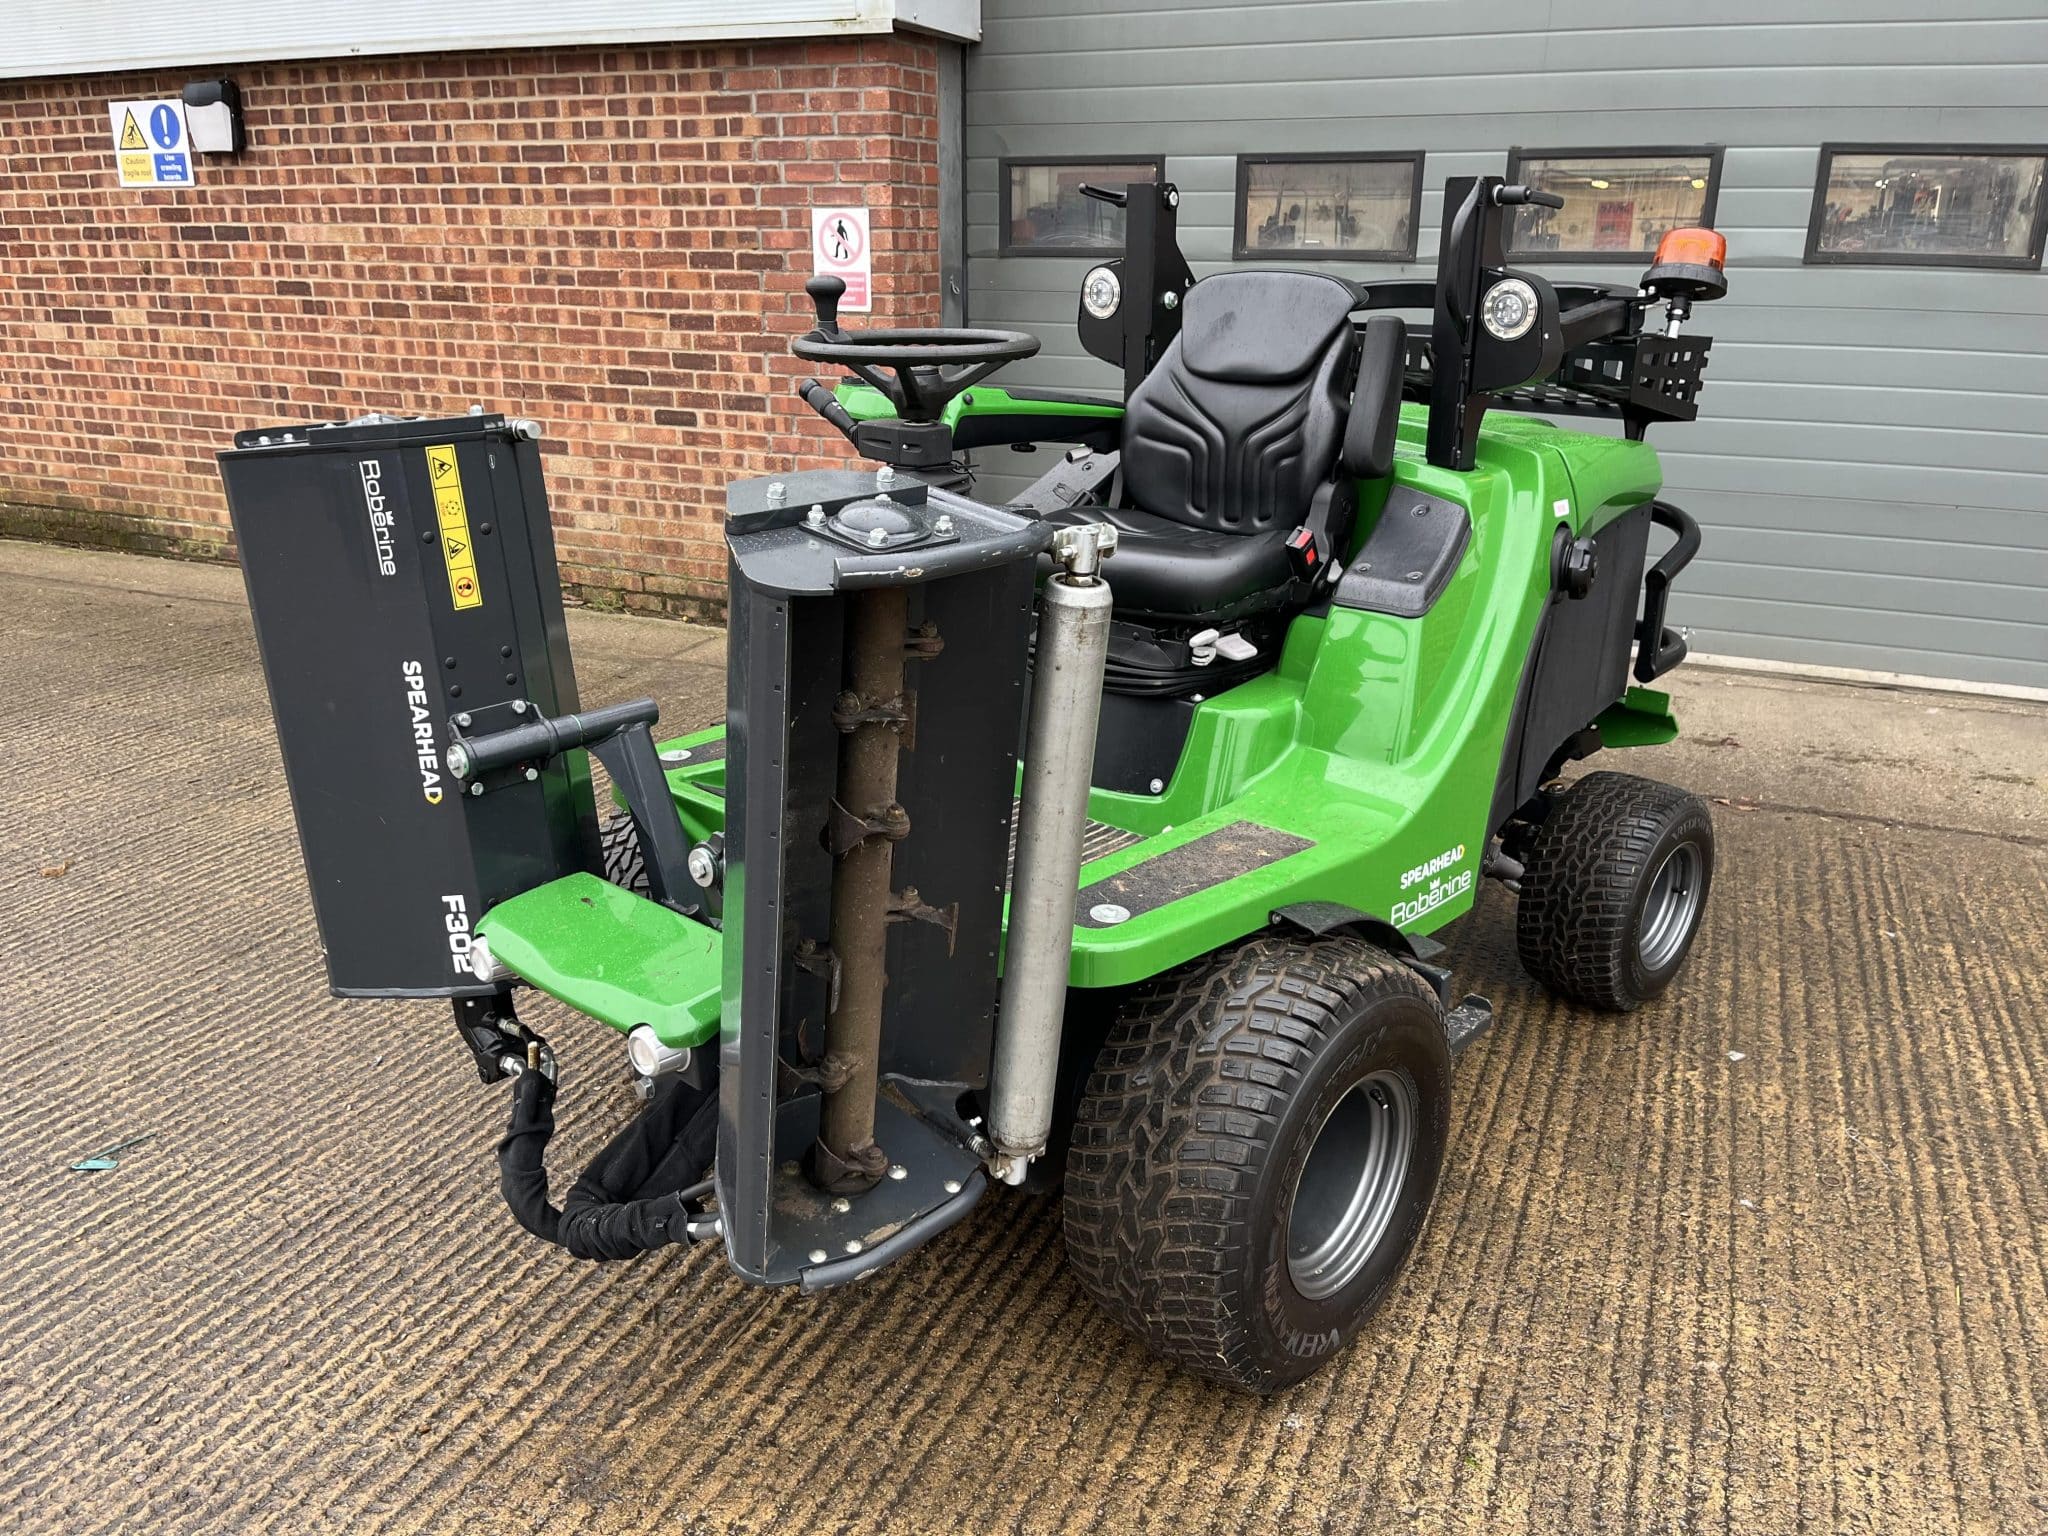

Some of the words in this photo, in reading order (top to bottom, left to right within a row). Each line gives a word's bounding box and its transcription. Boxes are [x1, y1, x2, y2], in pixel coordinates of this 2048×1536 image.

[125, 157, 146, 165] Caution
[360, 459, 396, 576] Roberine
[402, 660, 443, 805] SPEARHEAD
[1390, 869, 1471, 926] Roberine
[1400, 843, 1465, 890] SPEARHEAD
[441, 894, 474, 974] F302
